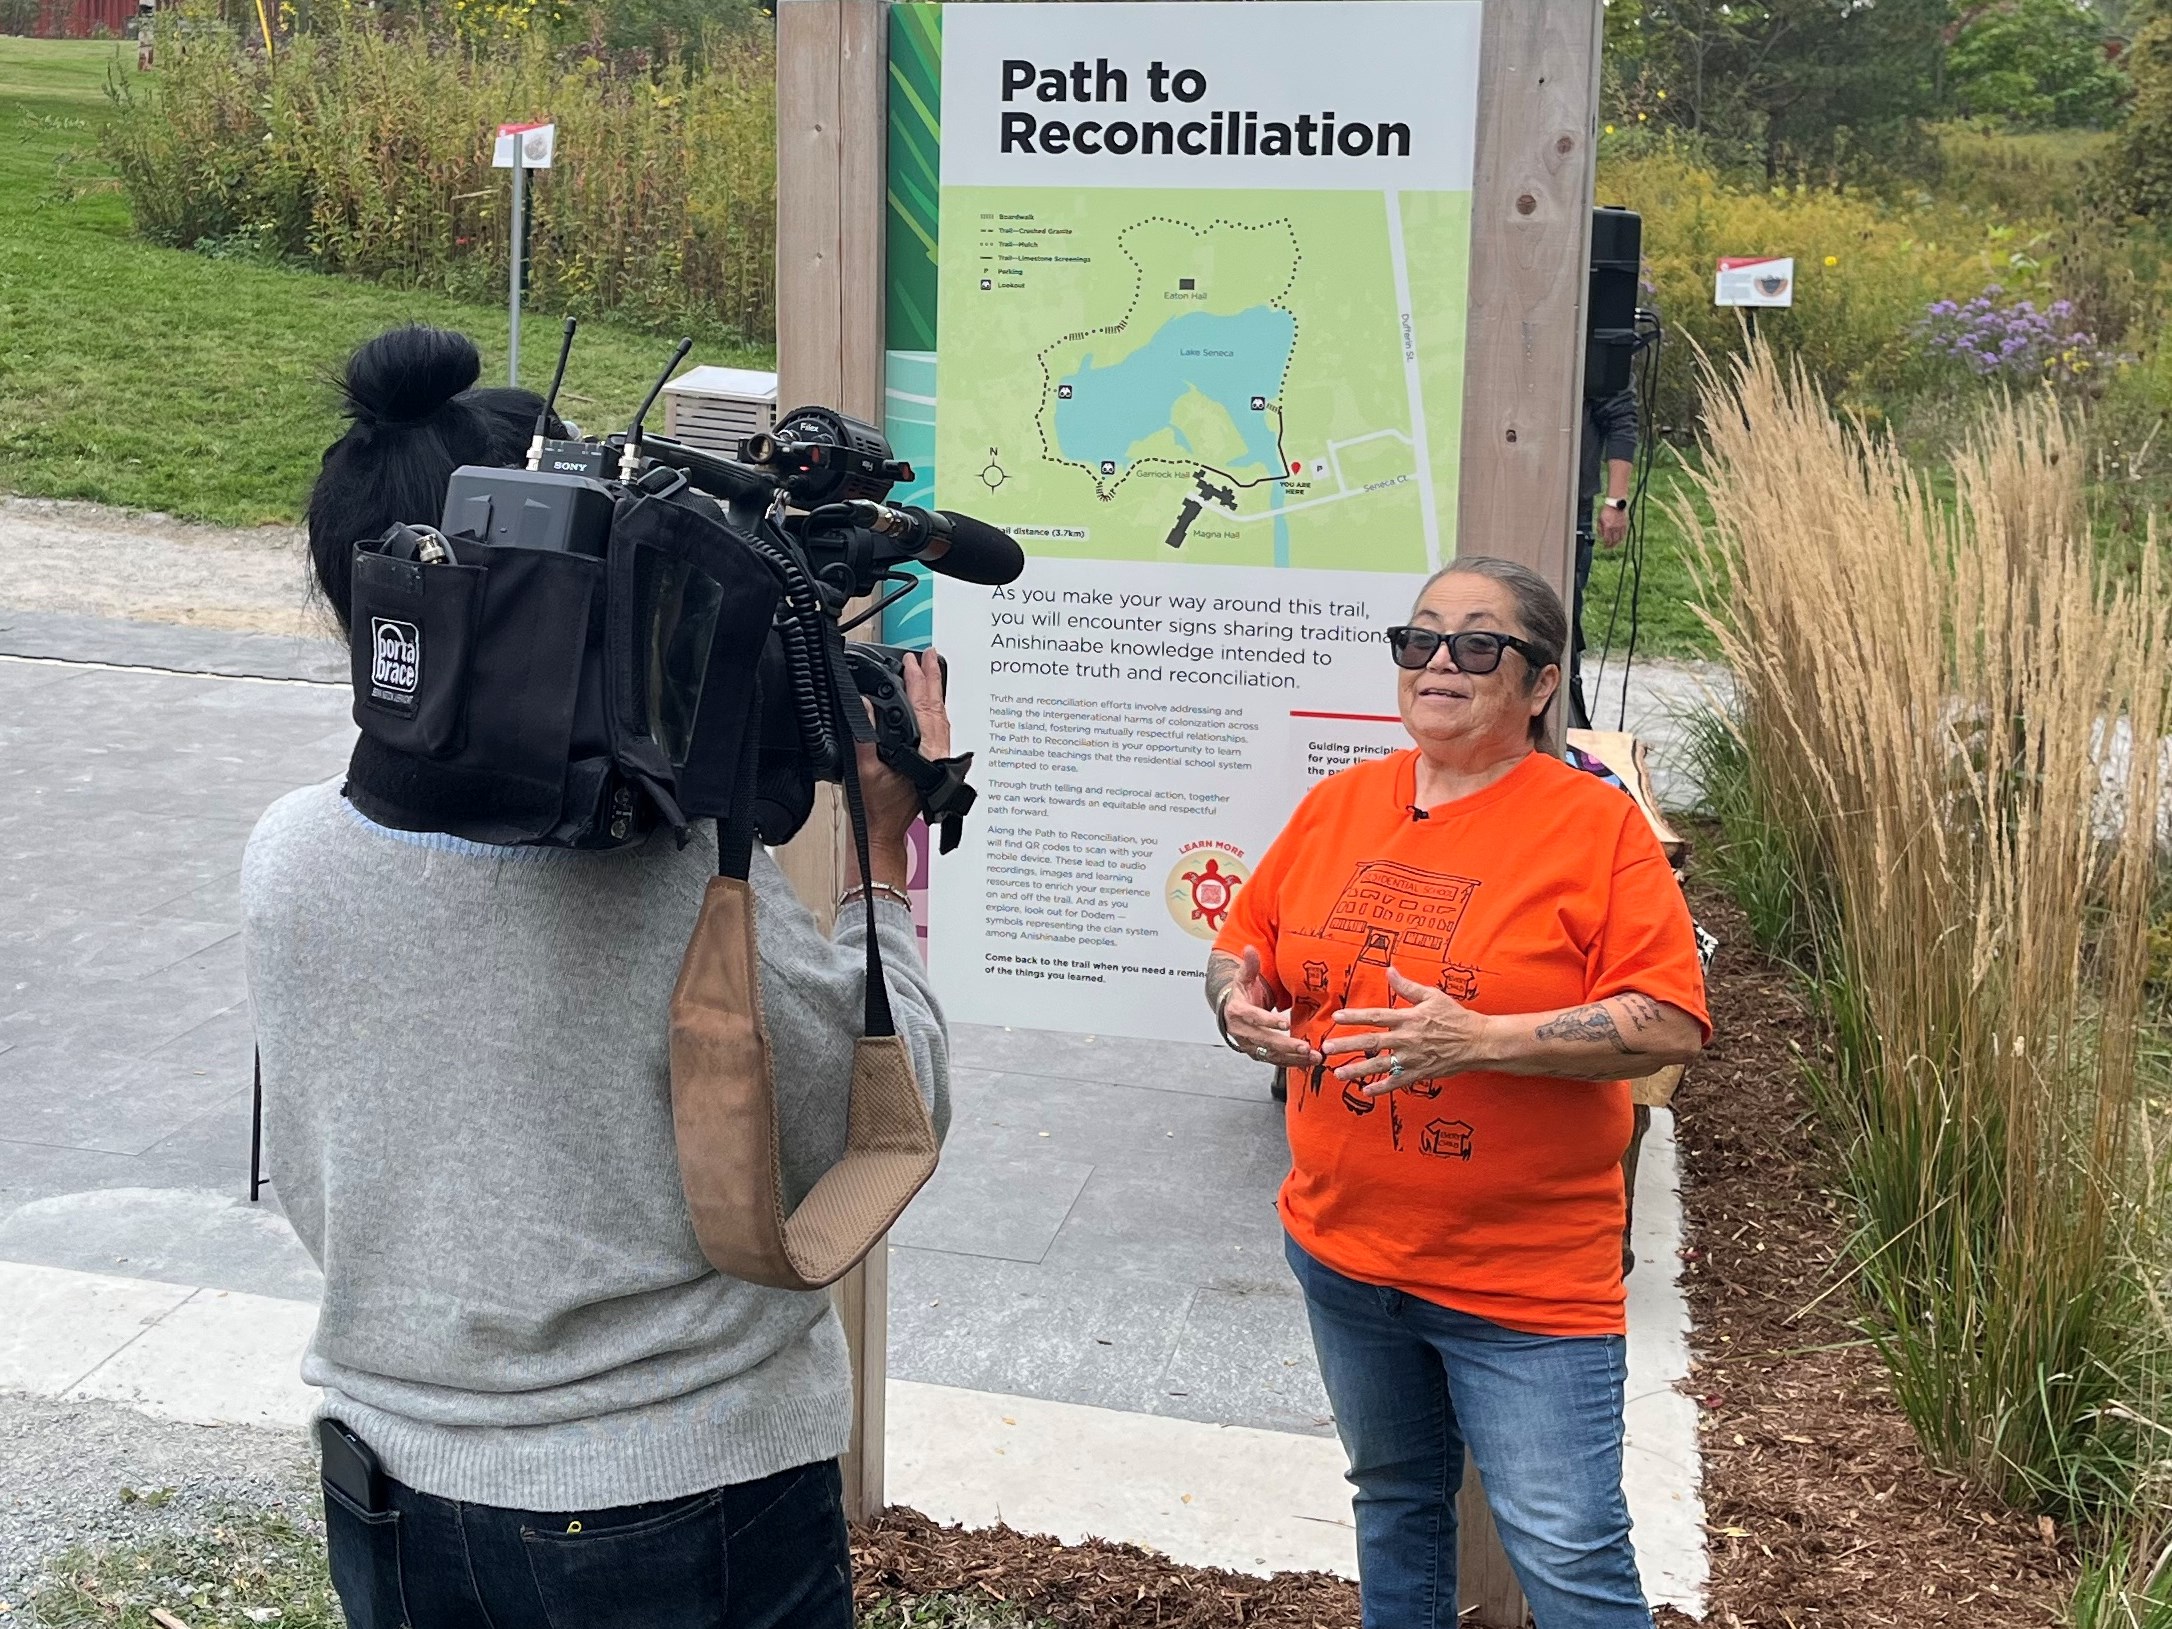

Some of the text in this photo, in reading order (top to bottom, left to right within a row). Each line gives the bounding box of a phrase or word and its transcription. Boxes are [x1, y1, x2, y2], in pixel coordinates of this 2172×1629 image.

[1002, 58, 1207, 103] Path to
[1000, 111, 1410, 156] Reconciliation
[1164, 292, 1207, 300] Eaton Hall
[1402, 313, 1412, 349] Dufferin
[1180, 348, 1234, 357] Lake Seneca
[990, 447, 998, 456] N
[554, 461, 587, 471] SONY
[1136, 470, 1190, 479] Garriock Hall
[1285, 488, 1304, 496] HERE
[1363, 478, 1392, 492] Seneca
[1014, 528, 1049, 536] distance
[1052, 529, 1085, 538] (3.7km)
[1193, 530, 1240, 539] Magna Hall
[992, 585, 1369, 618] As you make your way around this trail,
[991, 612, 1390, 643] you will encounter signs sharing traditiona
[378, 637, 416, 663] porta
[990, 632, 1332, 665] Anishinaabe knowledge intended to
[376, 659, 414, 686] brace
[990, 661, 1300, 688] promote truth and reconciliation.
[991, 693, 1242, 717] Truth and reconciliation efforts involve addressing and
[989, 706, 1259, 730] healing the intergenerational harms of colonization across
[990, 719, 1016, 729] Turtle
[1050, 722, 1091, 735] fostering
[1093, 726, 1134, 738] mutually
[1136, 729, 1184, 739] respectful
[989, 731, 1241, 756] The Path to Reconciliation is your opportunity to learn
[1308, 741, 1398, 755] Guiding principl
[988, 759, 1036, 771] attempted
[1039, 762, 1049, 770] to
[989, 745, 1252, 770] Anishinaabe teachings that the residential school system
[1308, 754, 1323, 762] for
[1327, 757, 1350, 765] your
[1308, 766, 1324, 775] the
[988, 778, 1027, 790] Through
[1029, 781, 1052, 790] truth
[1054, 783, 1082, 794] telling
[1084, 785, 1104, 794] and
[1105, 787, 1152, 797] reciprocal
[1188, 791, 1230, 802] together
[987, 805, 1008, 815] path
[988, 792, 1001, 800] we
[1003, 793, 1020, 801] can
[1023, 794, 1046, 803] work
[1048, 795, 1086, 805] towards
[1102, 800, 1146, 810] equitable
[1148, 802, 1166, 811] and
[1169, 805, 1216, 815] respectful
[987, 824, 1014, 836] Along
[1018, 826, 1032, 836] the
[1035, 827, 1056, 837] Path
[1058, 829, 1068, 838] to
[1140, 837, 1158, 845] you
[1178, 840, 1245, 858] LEARN MORE
[986, 930, 1017, 941] among
[1020, 930, 1075, 943] Anishinaabe
[984, 952, 1012, 962] Come
[1015, 954, 1038, 964] back
[1040, 957, 1050, 965] to
[1052, 957, 1068, 967] the
[1071, 959, 1090, 968] trail
[1092, 960, 1118, 970] when
[1121, 964, 1139, 973] you
[1141, 965, 1166, 974] need
[1176, 968, 1206, 977] remin
[985, 964, 1106, 982] of the things you learned.
